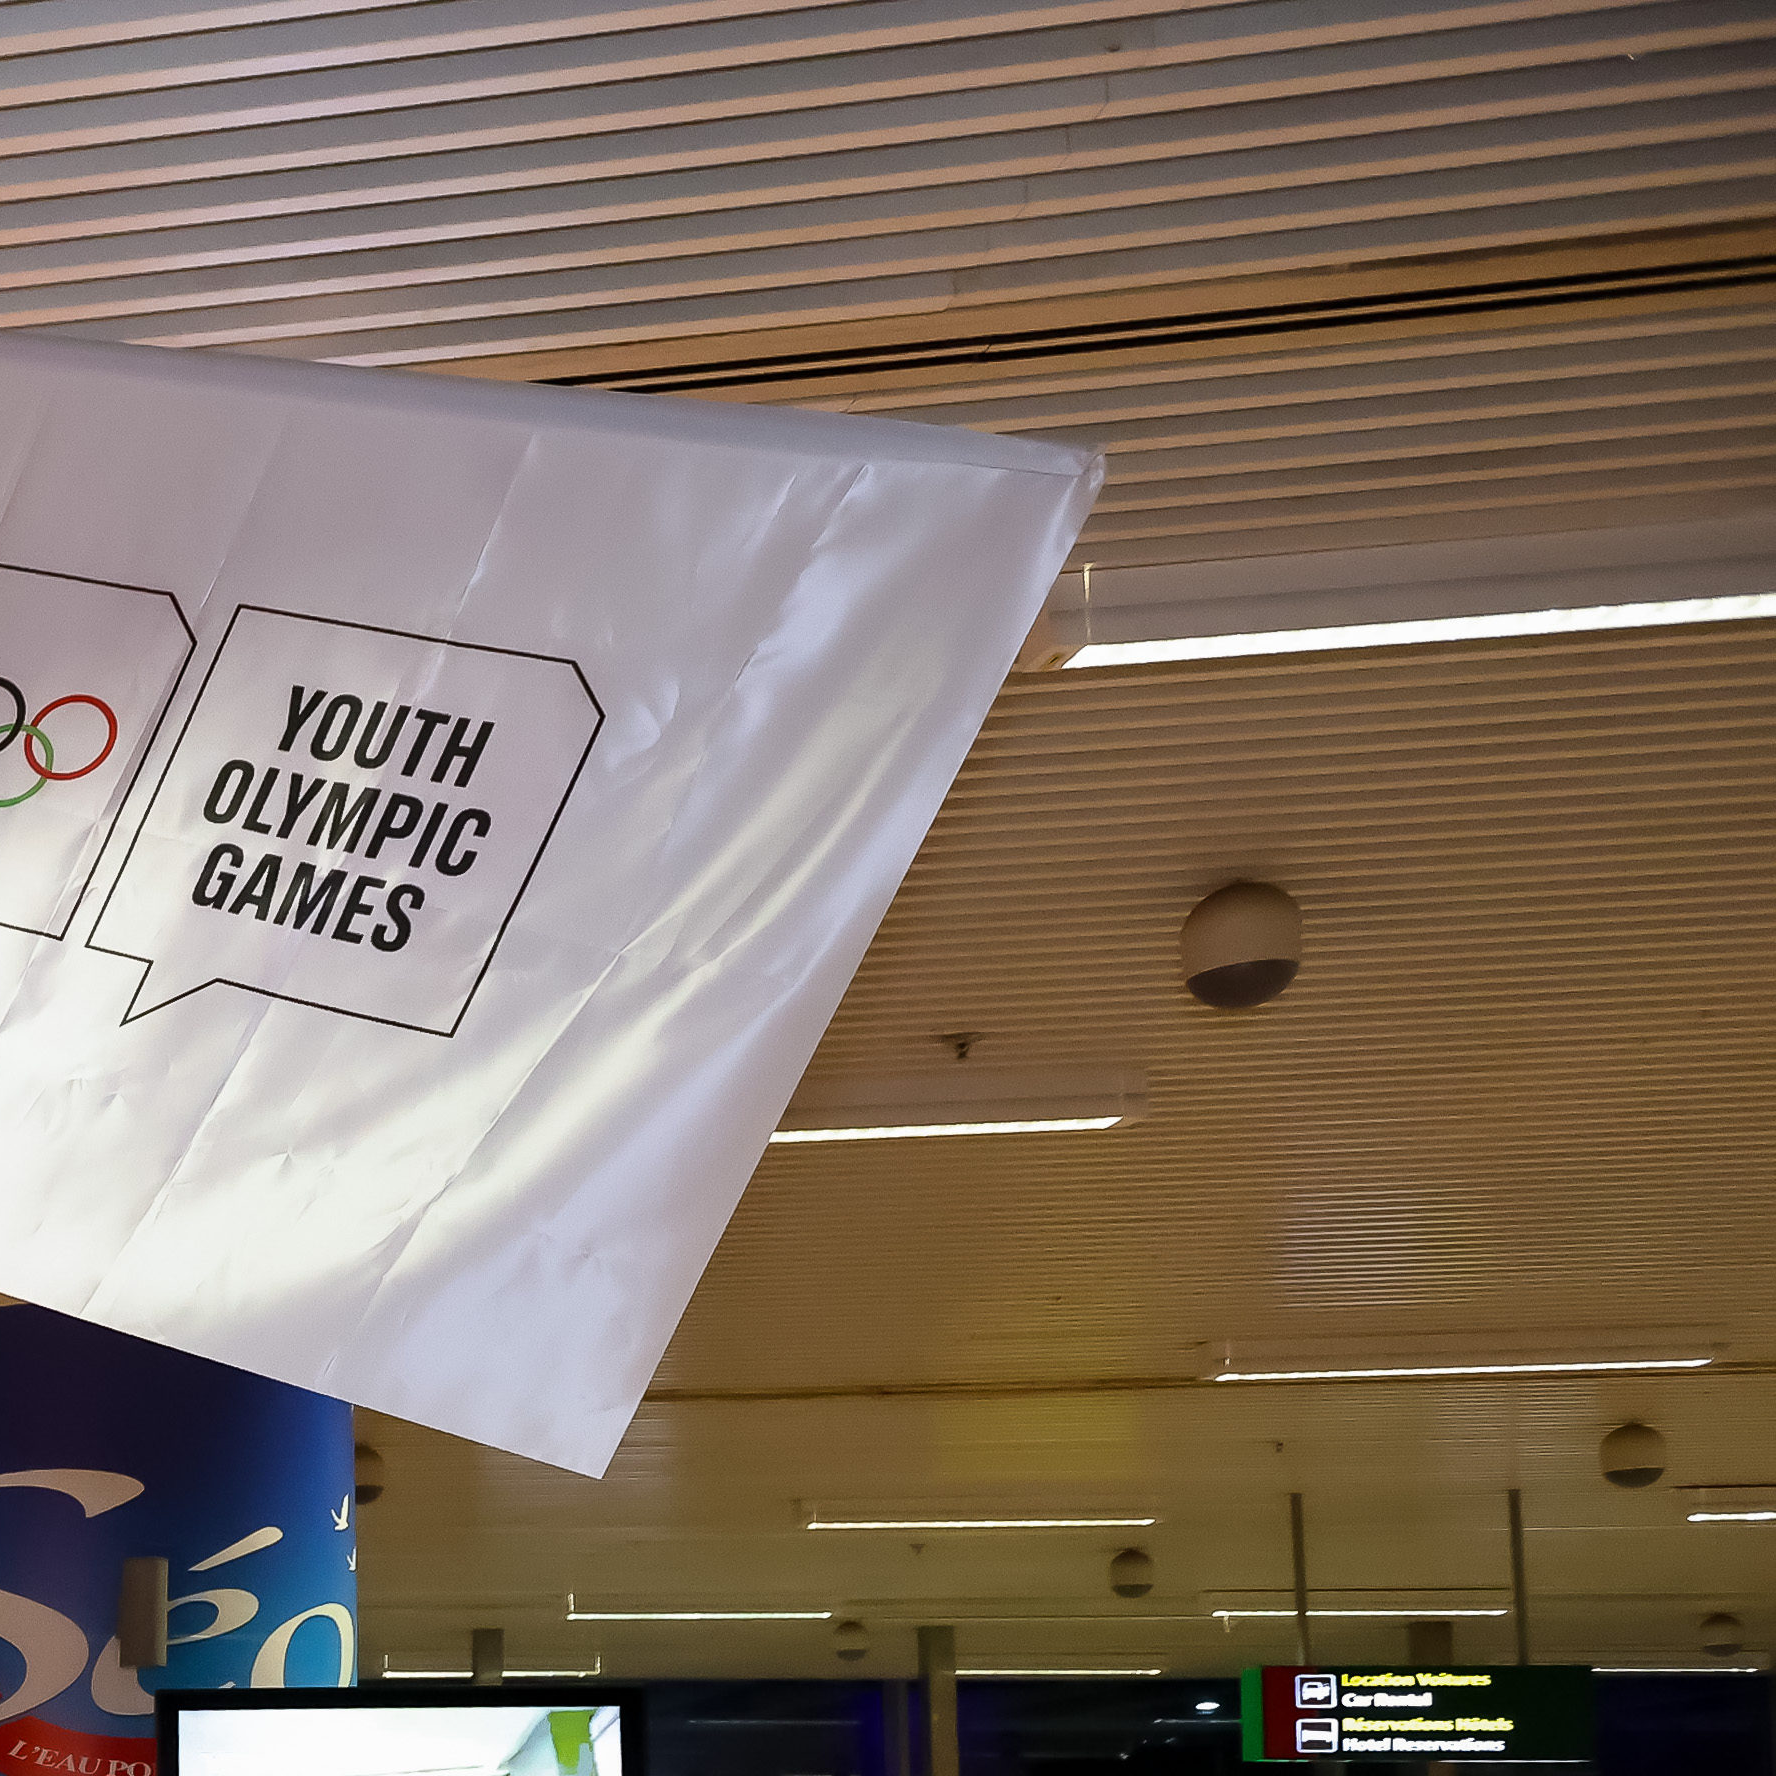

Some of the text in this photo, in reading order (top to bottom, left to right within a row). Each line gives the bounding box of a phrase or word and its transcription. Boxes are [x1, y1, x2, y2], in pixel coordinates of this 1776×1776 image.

[277, 685, 495, 788] YOUTH
[203, 760, 492, 876] OLYMPIC
[192, 843, 425, 952] GAMES
[1341, 1673, 1491, 1687] Location Voitures
[1341, 1692, 1433, 1707] Car Rental
[7, 1739, 102, 1775] L'EAU
[1342, 1737, 1506, 1751] Hotel Reservations
